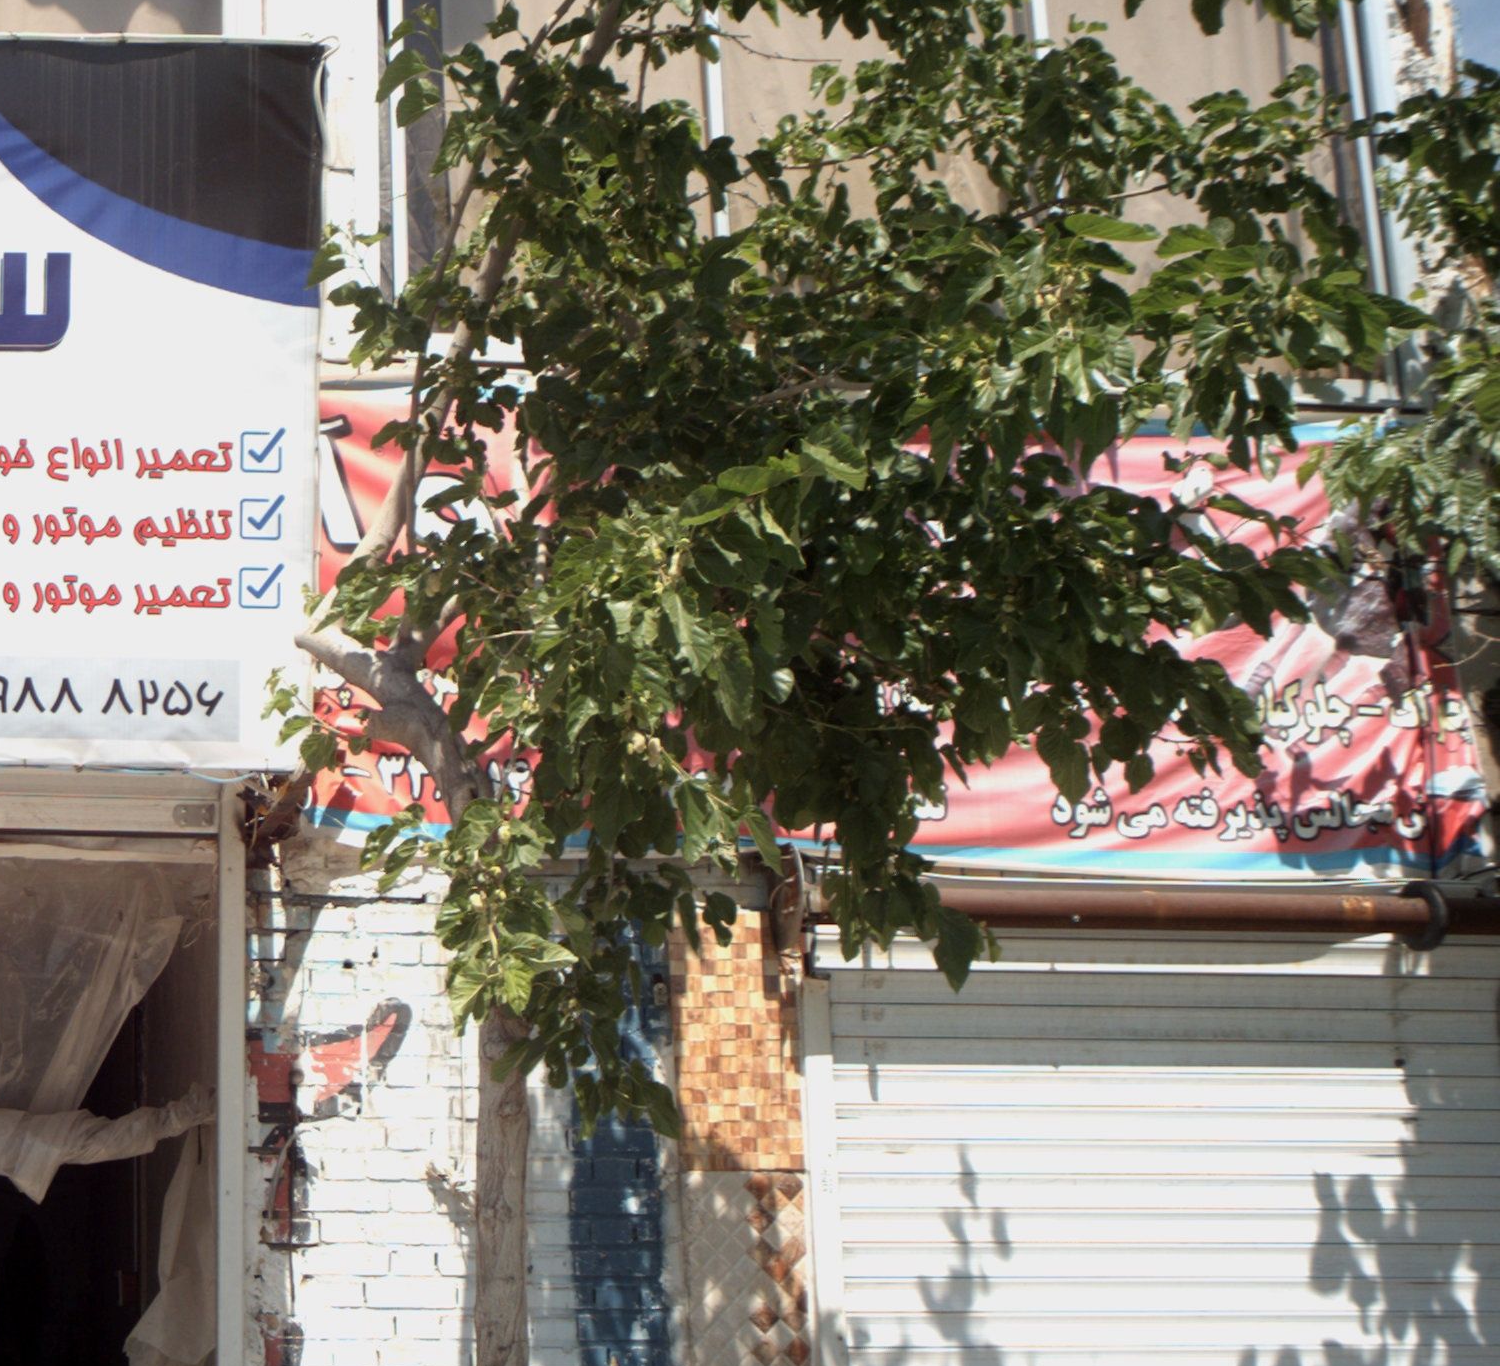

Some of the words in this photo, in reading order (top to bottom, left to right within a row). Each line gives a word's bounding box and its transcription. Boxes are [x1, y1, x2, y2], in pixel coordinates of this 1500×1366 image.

[46, 436, 126, 483] انواع
[135, 441, 235, 480] تعمیر
[2, 513, 22, 547] و
[32, 507, 124, 547] موتور
[133, 507, 234, 548] تنظیم
[3, 581, 22, 615] و
[33, 574, 124, 616] موتور
[134, 577, 234, 617] تعمیر
[101, 677, 226, 719] ۸۲۵۶
[1050, 787, 1114, 839] شود
[1116, 801, 1170, 839] می
[1172, 787, 1292, 843] پذیرفته
